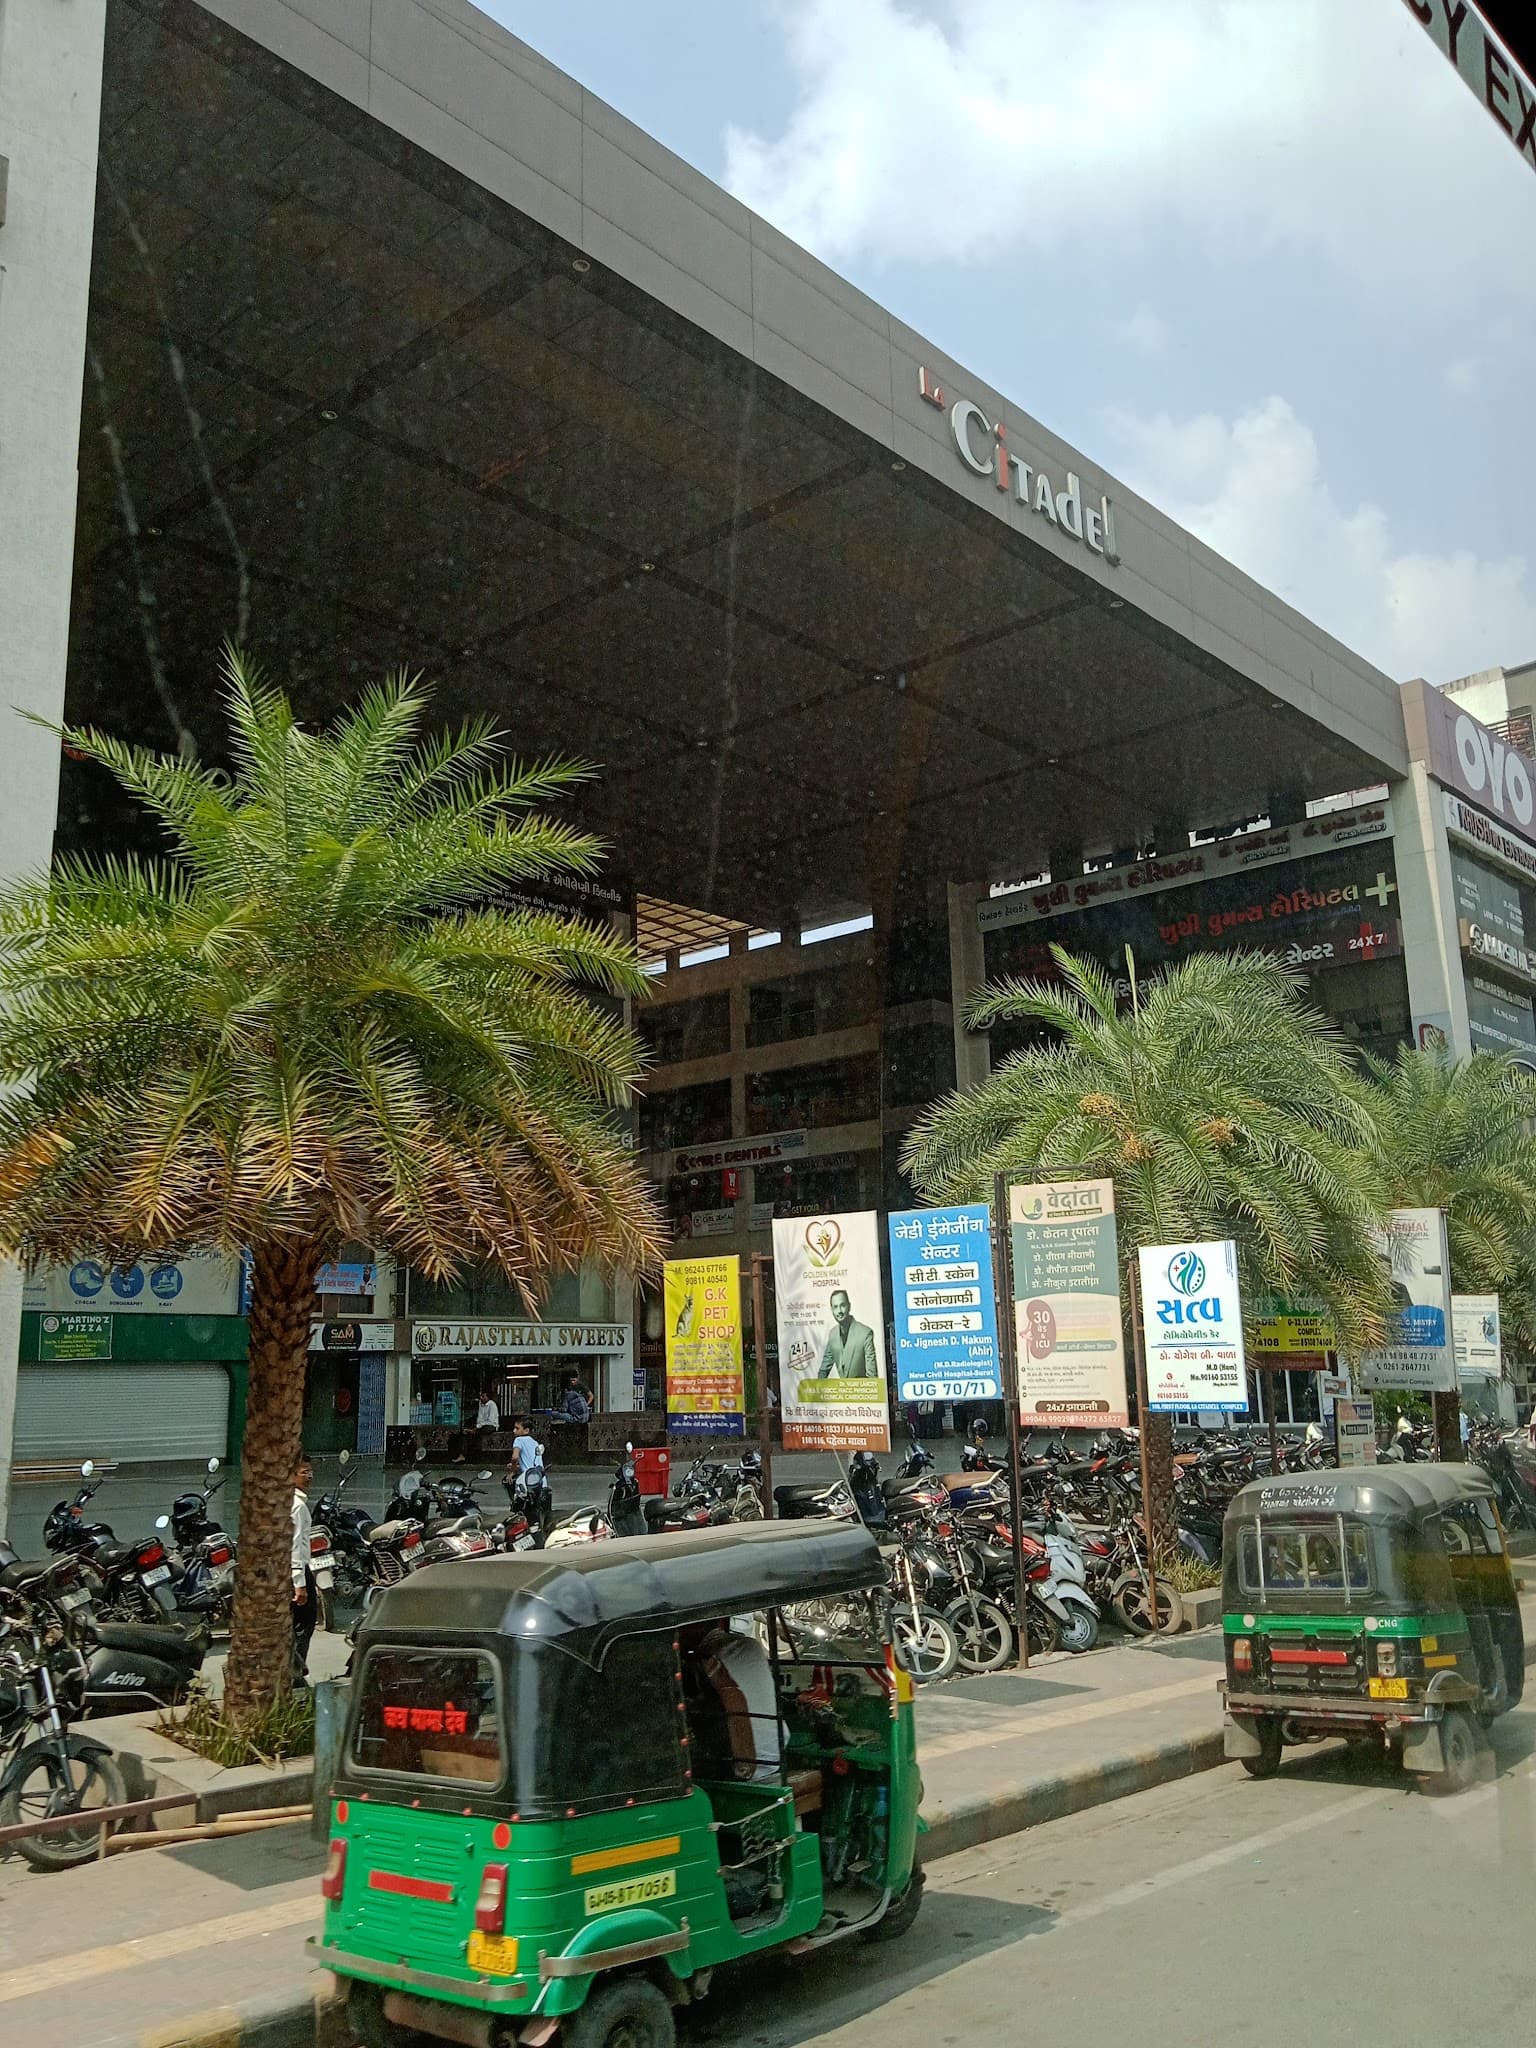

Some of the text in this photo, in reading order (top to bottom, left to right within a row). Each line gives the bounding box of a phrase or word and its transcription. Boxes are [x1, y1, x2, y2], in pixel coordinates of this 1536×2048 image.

[1455, 714, 1533, 826] OYO
[724, 1144, 782, 1163] DENTALS
[1047, 1186, 1101, 1209] वेदांता
[894, 1219, 923, 1240] जेडी
[1042, 1226, 1068, 1240] केतन
[920, 1241, 961, 1260] सेन्टर
[684, 1265, 705, 1274] 96243
[706, 1263, 728, 1273] 67766
[803, 1269, 849, 1279] GOLDEN HEART
[945, 1266, 975, 1280] स्केन
[812, 1278, 841, 1288] HOSPITAL
[704, 1286, 728, 1301] G.K
[913, 1290, 974, 1307] सोनोग्राफी
[704, 1306, 729, 1320] PET
[1033, 1311, 1051, 1324] 30
[1156, 1297, 1224, 1325] સત્વ
[67, 1324, 104, 1333] PIZZA
[331, 1328, 355, 1340] SAM
[698, 1324, 736, 1340] SHOP
[439, 1326, 626, 1351] RAJASTHAN SWEETS
[901, 1334, 993, 1349] Dr. Jignesh D. Nakum
[1035, 1340, 1051, 1348] ICU
[968, 1345, 994, 1358] (Ahir)
[1383, 1362, 1399, 1371] 0261
[927, 1371, 942, 1379] Civil
[913, 1381, 986, 1397] UG 70/71
[1378, 1619, 1398, 1628] CNG
[101, 1671, 147, 1687] Activa
